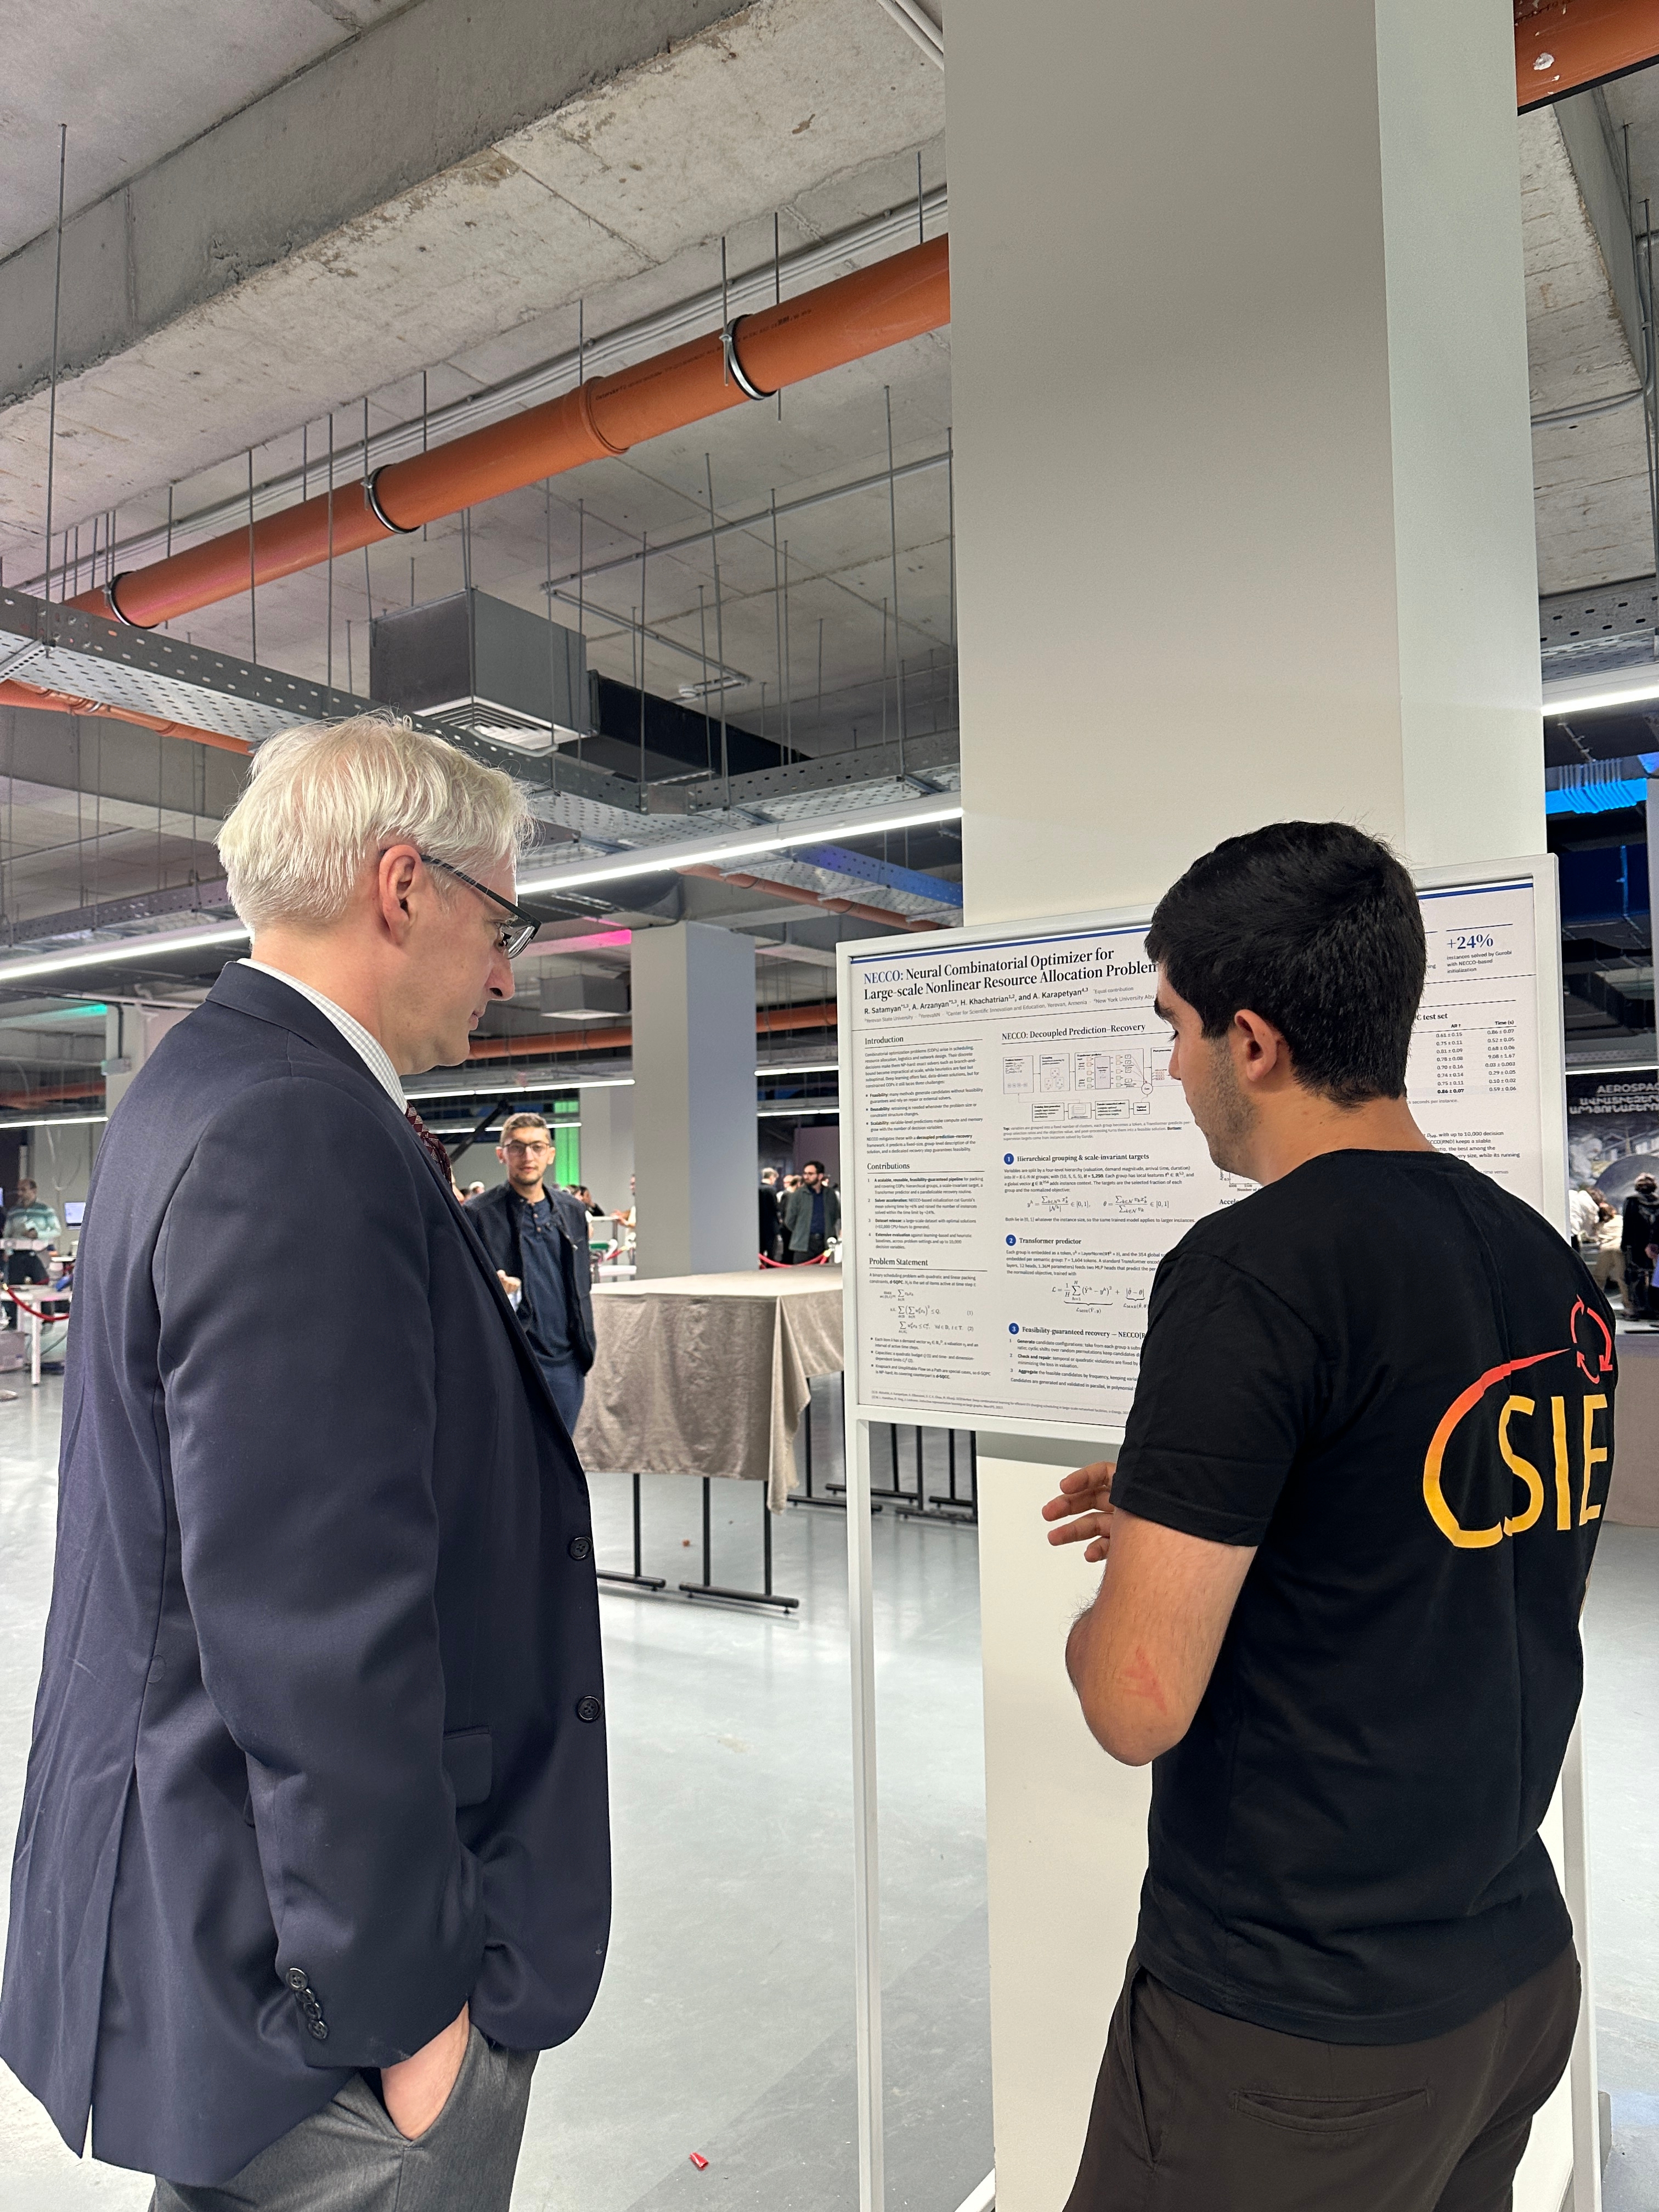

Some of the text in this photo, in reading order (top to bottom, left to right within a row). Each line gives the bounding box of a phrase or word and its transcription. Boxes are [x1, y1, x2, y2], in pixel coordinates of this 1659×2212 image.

[1447, 934, 1493, 949] +24%
[864, 947, 1114, 984] NECCO: Neural Combinatorial Optimizer for
[864, 983, 923, 1000] Large-scale
[926, 980, 981, 994] Nonlinear
[984, 975, 1037, 988] Resource
[1040, 967, 1102, 983] Allocation
[1002, 1025, 1146, 1040] NECCO: Decoupled Prediction–Recovery
[865, 1036, 903, 1045] Introduction
[1022, 1327, 1084, 1335] Feasibility-guaranteed
[1423, 1348, 1608, 1549] CSIE
